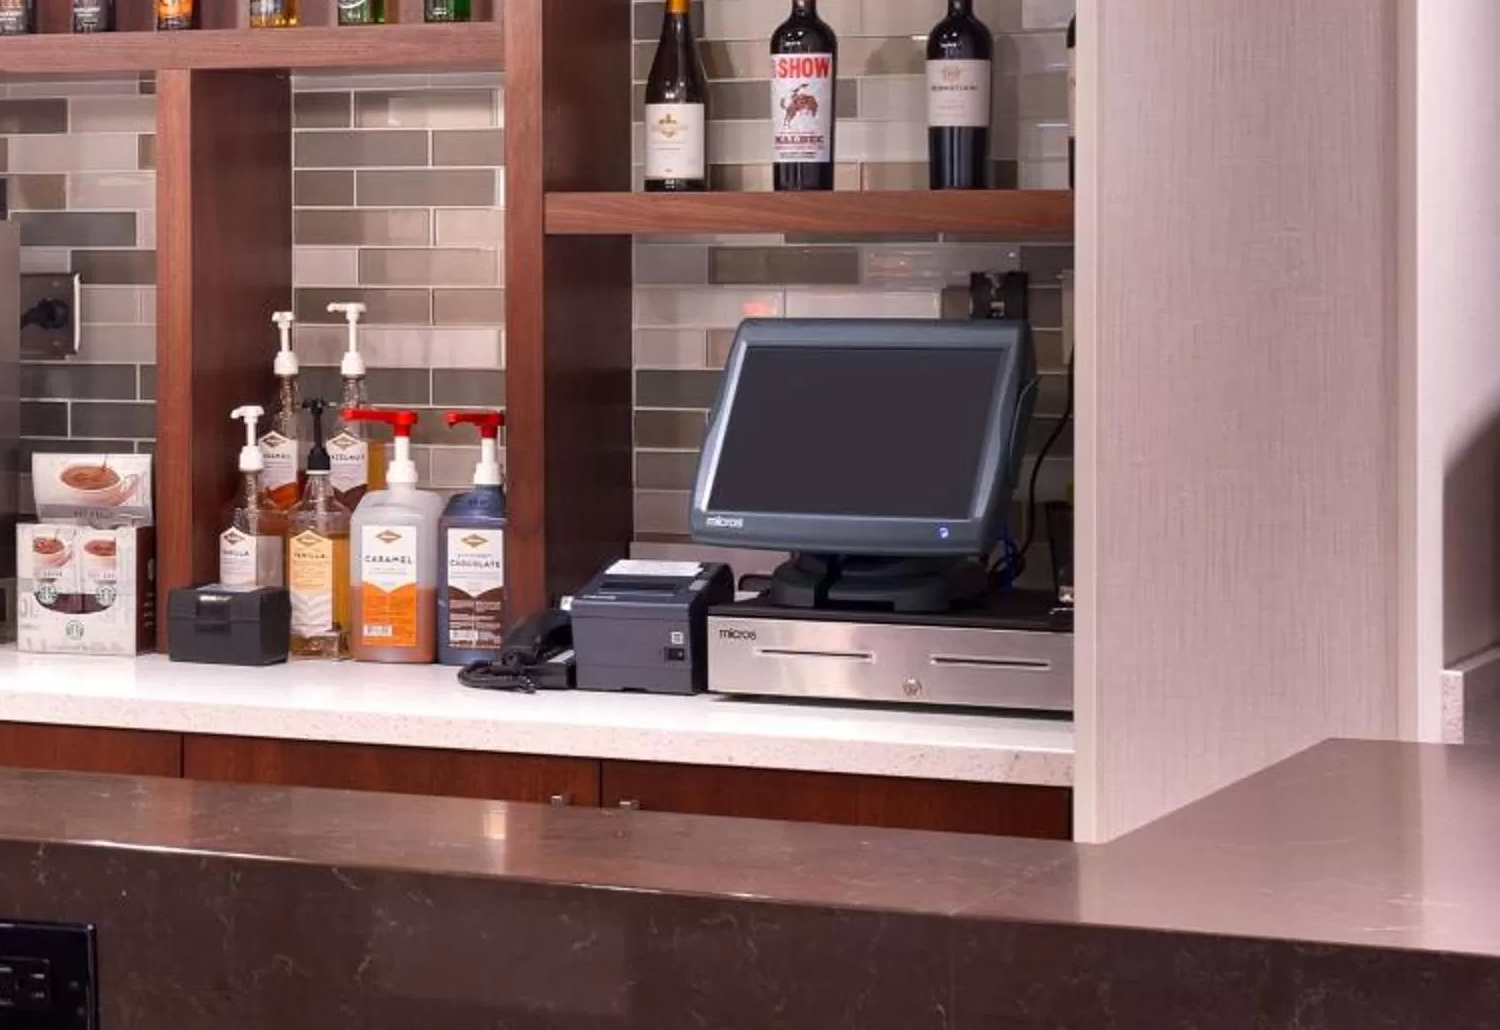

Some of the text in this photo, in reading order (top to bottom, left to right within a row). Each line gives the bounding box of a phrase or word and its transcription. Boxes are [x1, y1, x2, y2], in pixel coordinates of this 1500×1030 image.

[778, 58, 830, 78] SHOW
[364, 555, 412, 564] CARAMEL
[719, 628, 756, 640] micros
